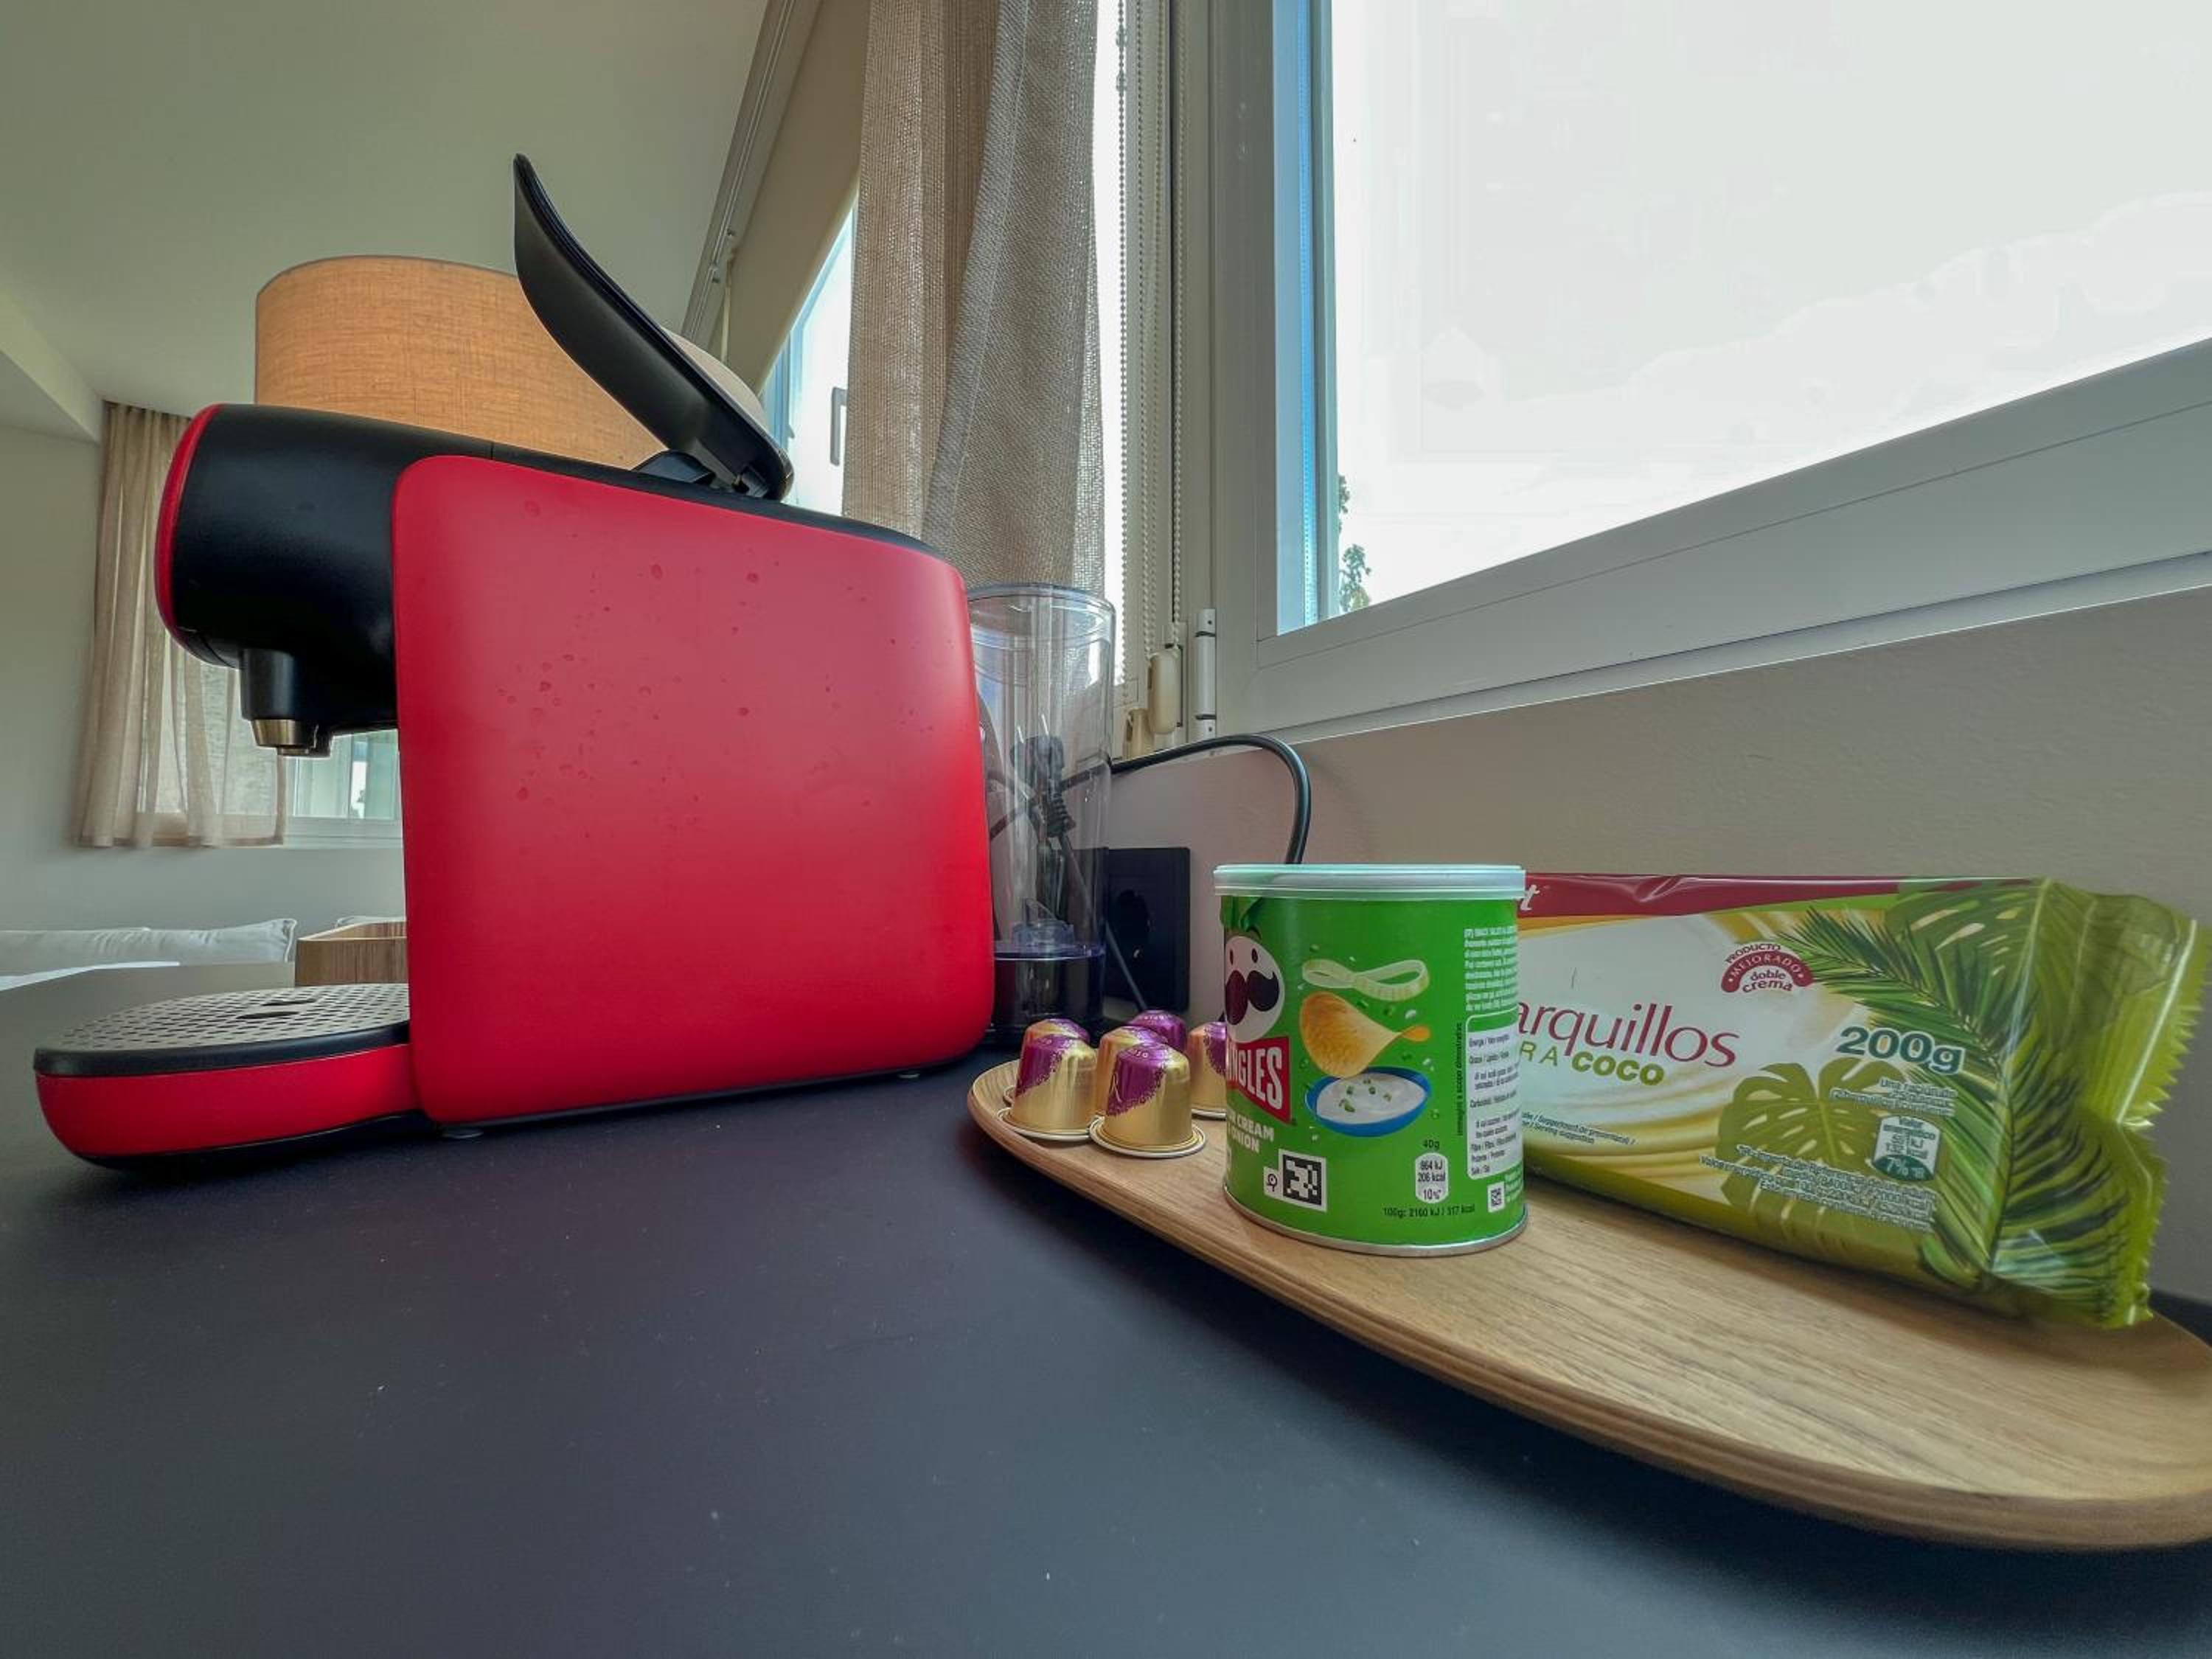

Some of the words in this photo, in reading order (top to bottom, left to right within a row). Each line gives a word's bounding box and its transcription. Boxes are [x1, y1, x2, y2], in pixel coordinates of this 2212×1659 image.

[1742, 980, 1792, 992] crema
[1750, 970, 1786, 981] doble
[1517, 1001, 1740, 1068] arquillos
[1835, 1026, 1964, 1076] 200g
[1571, 1051, 1665, 1086] coco
[1237, 1113, 1275, 1143] CREAM
[1423, 1139, 1440, 1150] 40g
[1432, 1172, 1445, 1182] kcal
